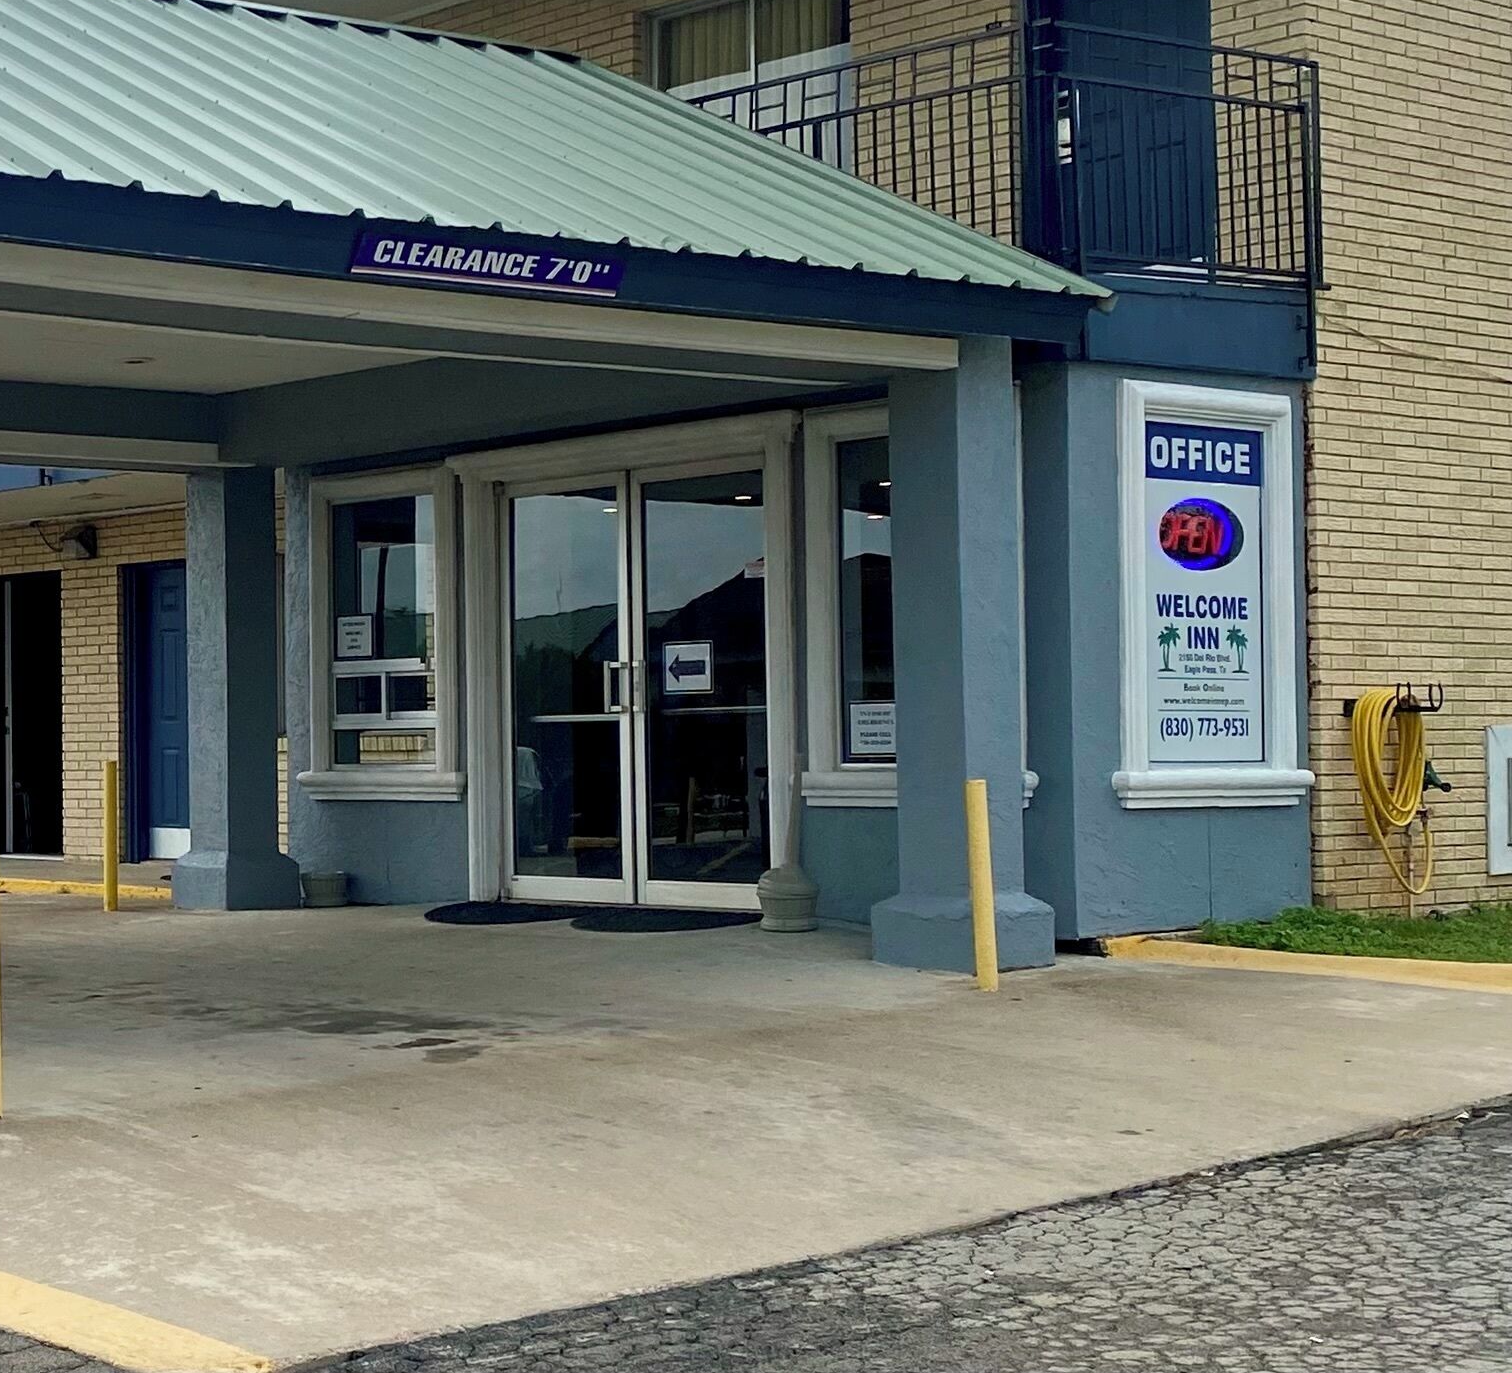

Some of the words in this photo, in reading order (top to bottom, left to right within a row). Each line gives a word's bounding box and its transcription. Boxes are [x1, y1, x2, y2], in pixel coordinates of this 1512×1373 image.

[373, 239, 541, 278] CLEARANCE
[1150, 435, 1251, 475] OFFICE
[1162, 512, 1224, 555] OPEN
[1156, 593, 1249, 620] WELCOME
[1187, 625, 1220, 650] INN
[1202, 683, 1225, 693] Online
[1160, 717, 1194, 742] (830)
[1197, 717, 1249, 737] 773-9531
